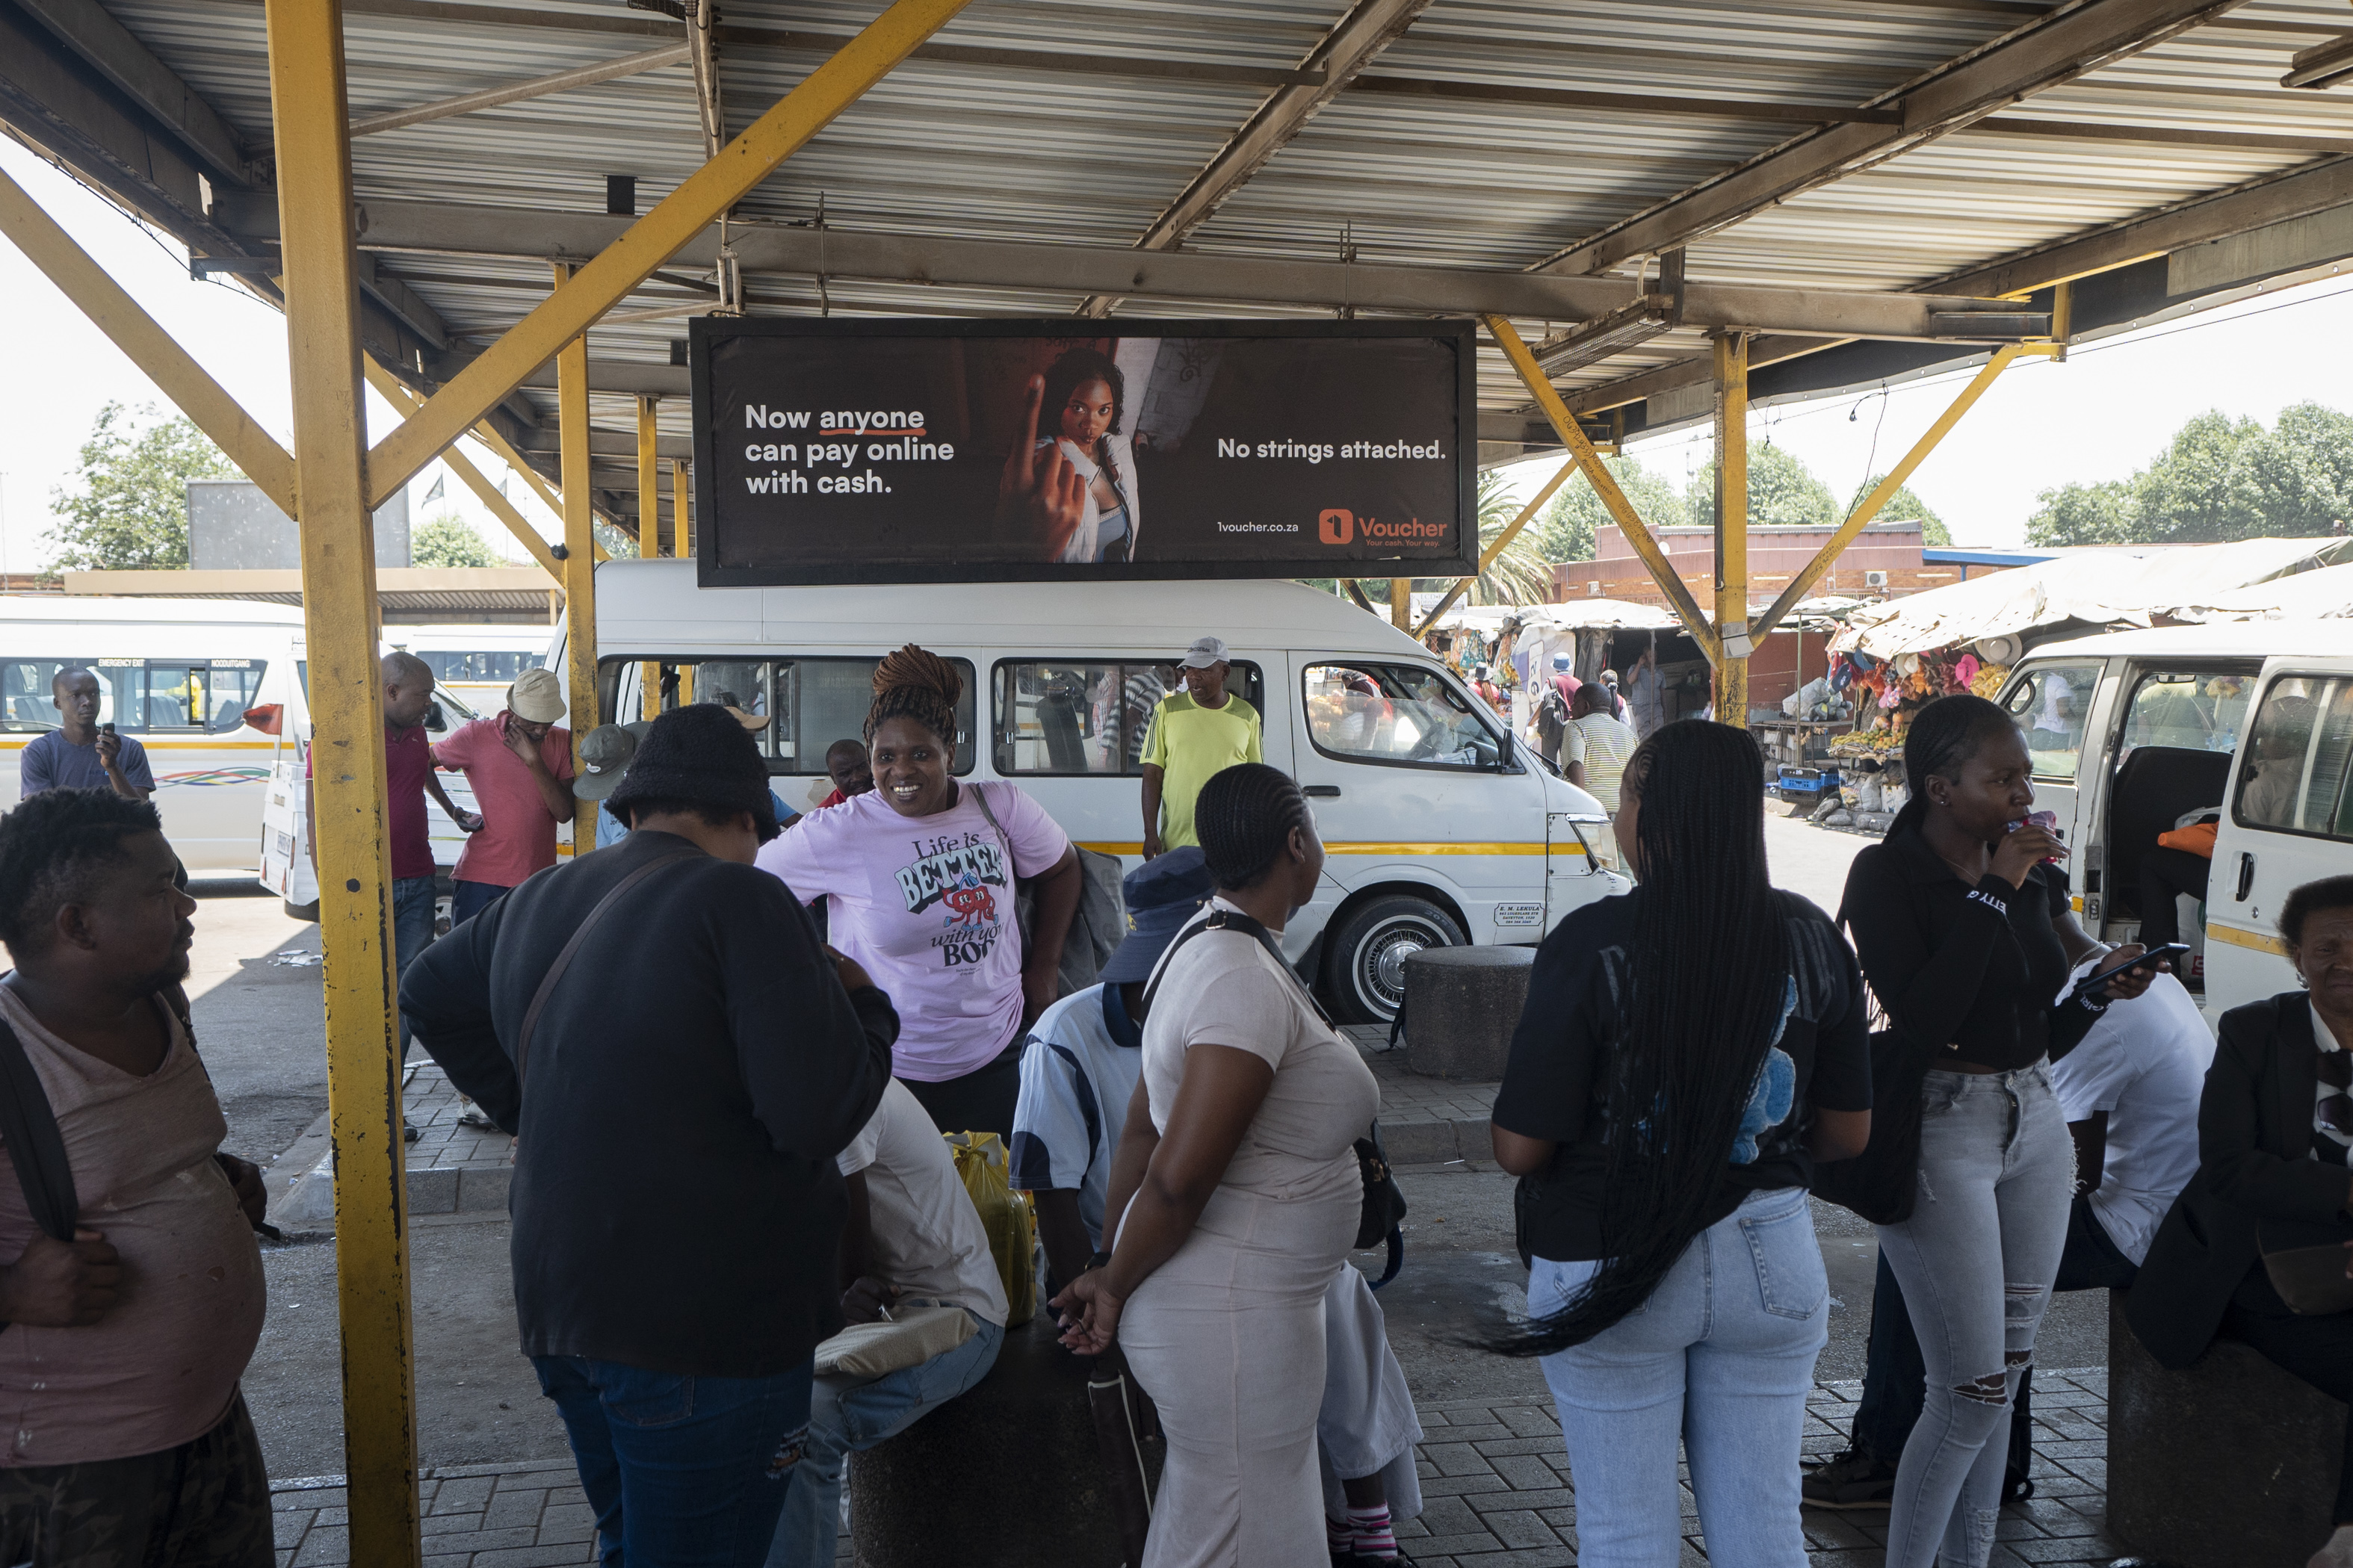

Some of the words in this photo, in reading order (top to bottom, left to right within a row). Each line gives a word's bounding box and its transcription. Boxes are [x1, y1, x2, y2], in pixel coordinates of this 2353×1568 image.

[746, 404, 811, 428] Now
[820, 411, 924, 436] anyone
[745, 444, 797, 461] can
[807, 444, 859, 468] pay
[867, 436, 954, 460] online
[1218, 439, 1250, 458] No
[1257, 439, 1334, 464] strings
[1341, 439, 1446, 459] attached.
[745, 469, 808, 494] with
[817, 469, 891, 493] cash.
[1217, 521, 1299, 533] 1voucher.co.za
[1358, 518, 1447, 537] Voucher
[1423, 540, 1440, 548] way.
[98, 658, 132, 667] EMERGENCY
[132, 658, 145, 667] EXIT
[211, 659, 251, 668] NOODUITGANG
[912, 835, 959, 860] Life
[963, 831, 980, 847] is
[894, 842, 1007, 915] BETTER
[930, 929, 974, 948] with
